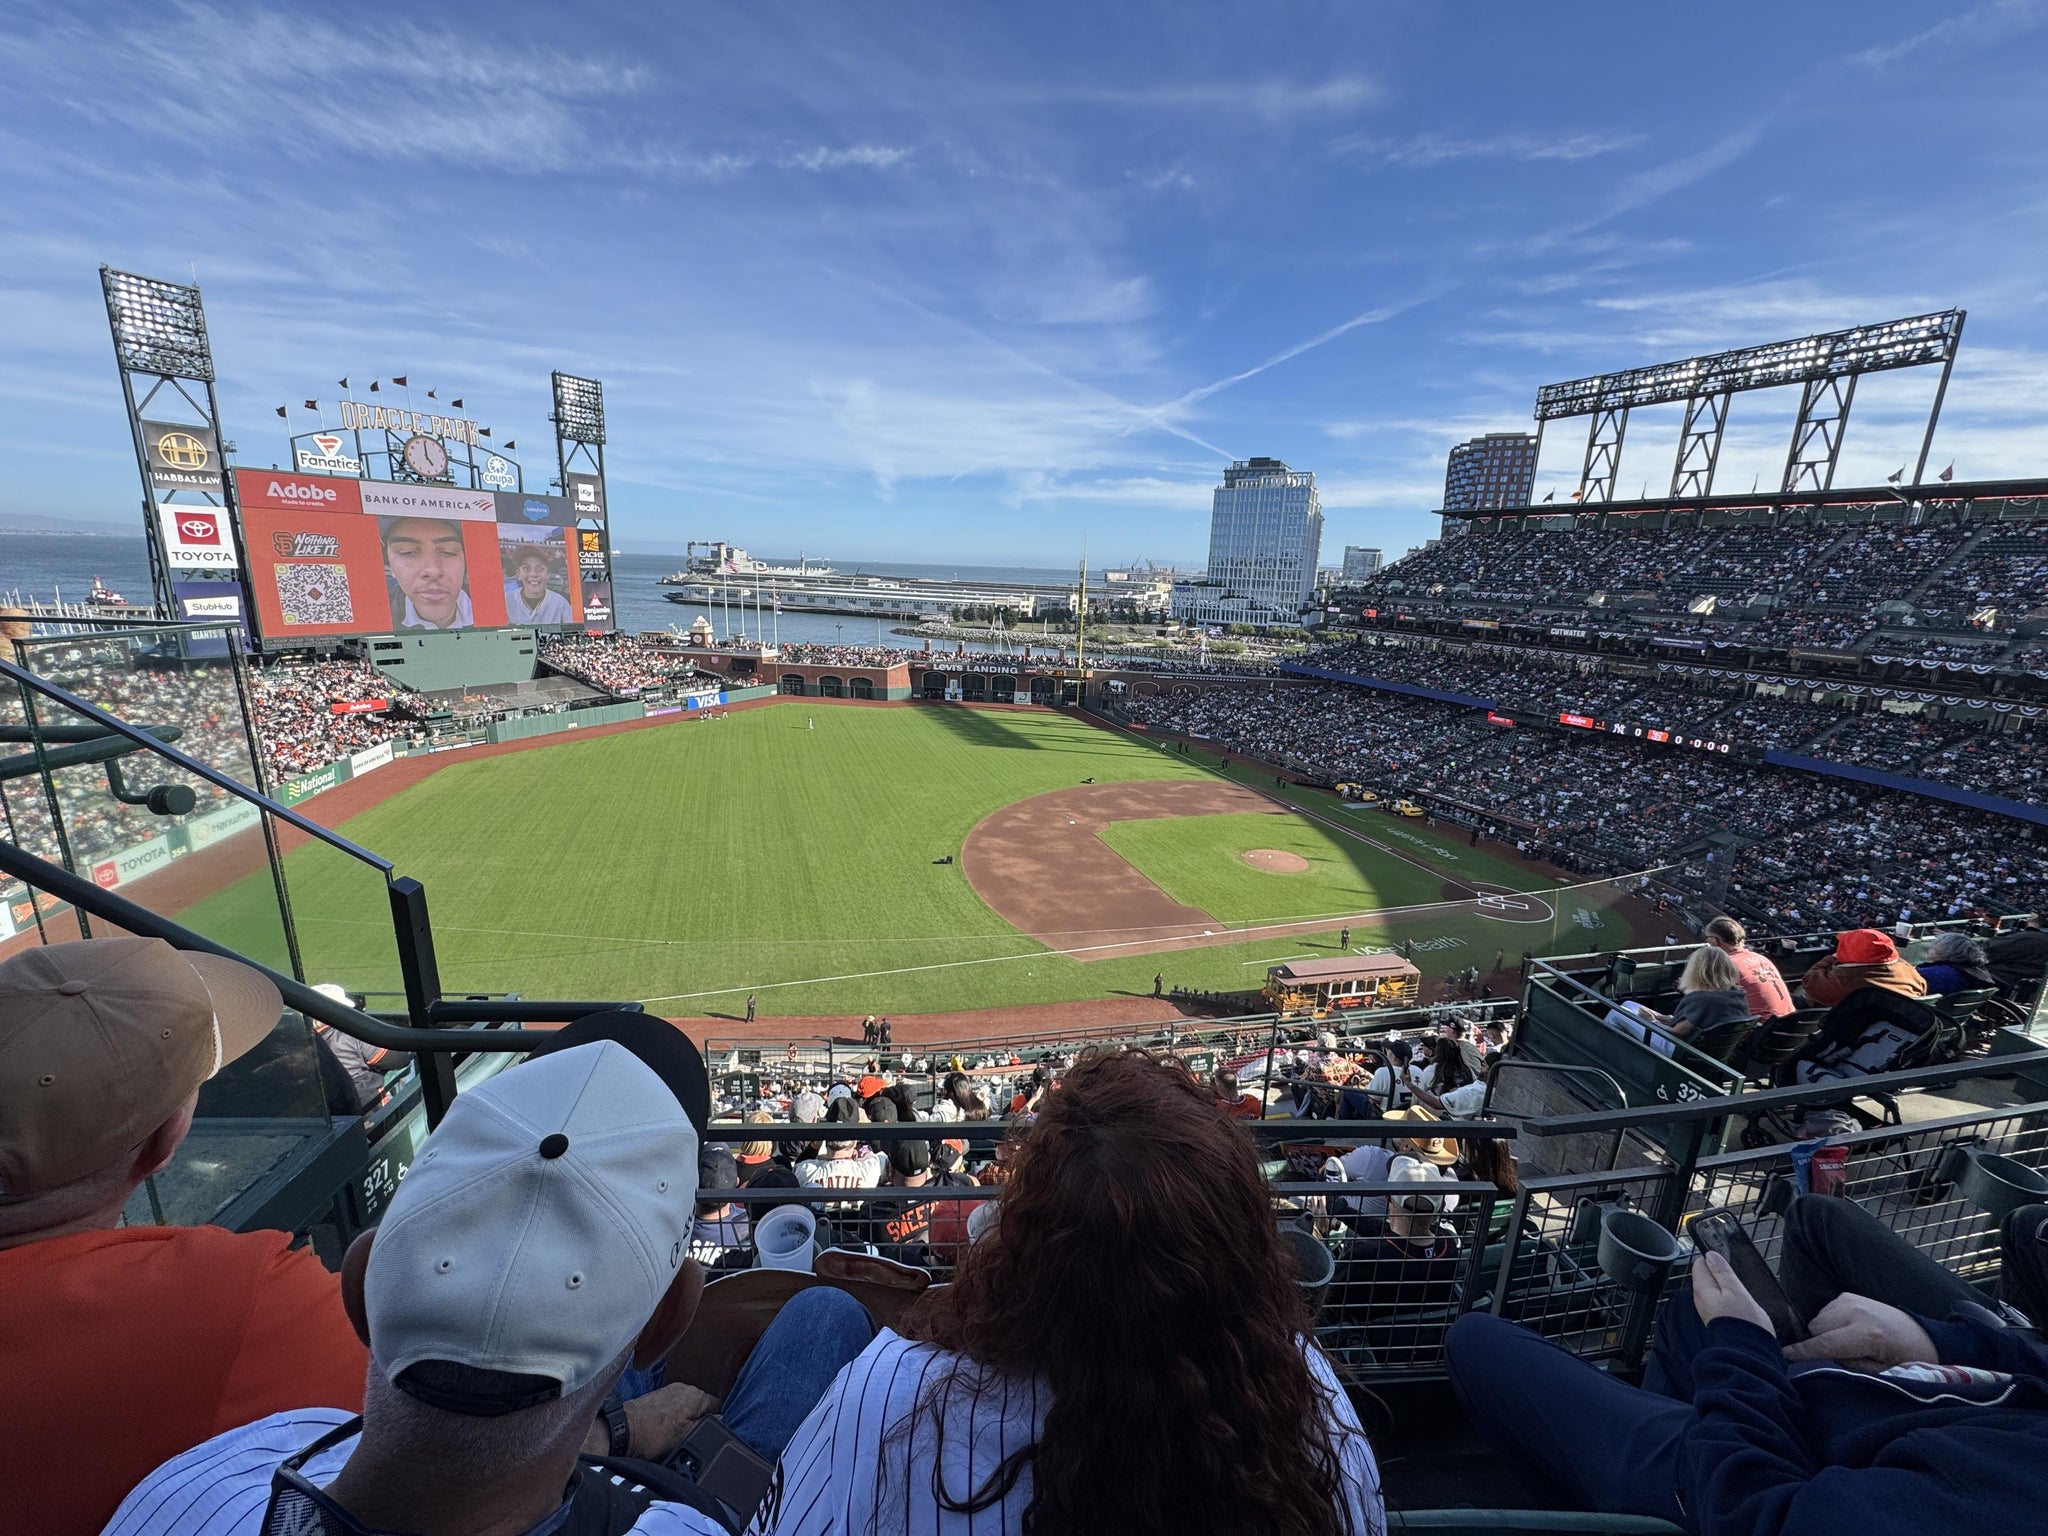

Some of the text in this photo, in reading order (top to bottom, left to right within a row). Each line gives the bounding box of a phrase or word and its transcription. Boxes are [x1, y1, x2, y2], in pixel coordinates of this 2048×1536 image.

[341, 401, 481, 448] ORACLE PARK
[300, 453, 361, 470] Fanatics
[155, 473, 220, 485] HABBAS LAW
[484, 474, 513, 485] coupa
[267, 481, 337, 501] Adobe
[365, 494, 471, 510] BANK OF AMERICA
[574, 502, 600, 512] Health
[294, 533, 336, 545] NOTHING
[294, 544, 339, 555] LIKE IT
[579, 551, 605, 559] CACHE
[171, 551, 234, 562] TOYOTA
[192, 603, 233, 611] StubHub
[583, 606, 611, 615] Benjamin
[191, 629, 219, 640] GIANTS
[1551, 627, 1587, 638] CUTWATER
[966, 664, 1019, 675] LANDING
[695, 694, 721, 709] VISA
[1634, 728, 1642, 737] 0
[1674, 736, 1683, 745] 0
[1694, 739, 1702, 748] 0
[1707, 742, 1716, 751] 0
[1721, 744, 1729, 754] 0
[300, 767, 335, 794] National
[120, 846, 167, 873] TOYOTA
[363, 1158, 389, 1198] 327
